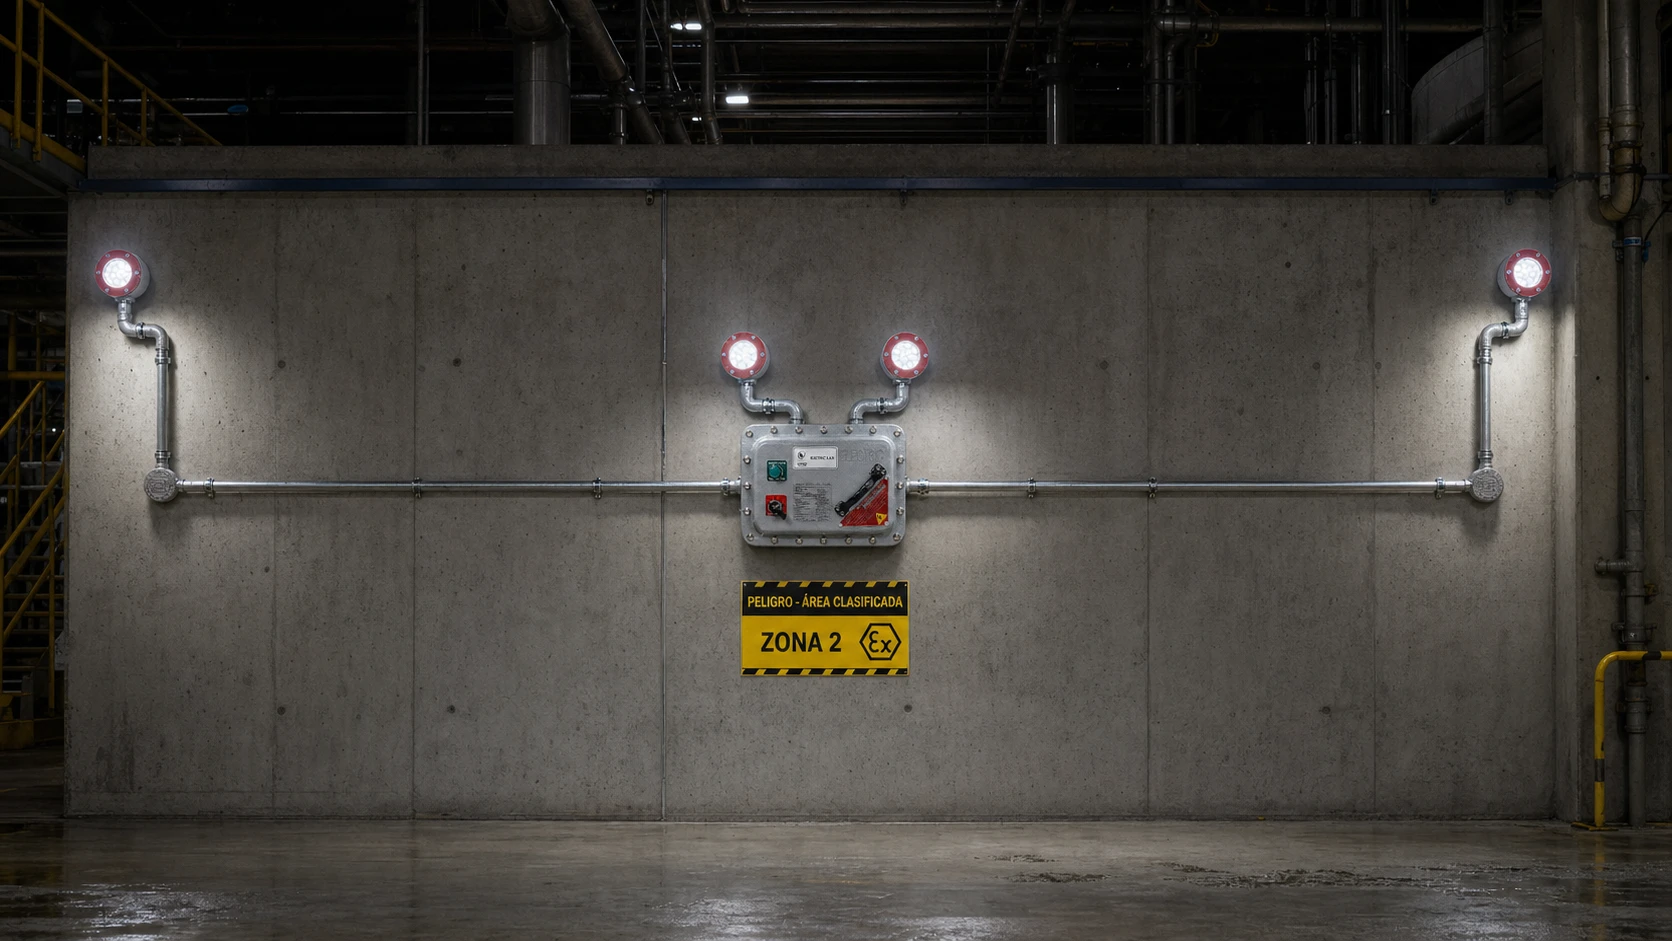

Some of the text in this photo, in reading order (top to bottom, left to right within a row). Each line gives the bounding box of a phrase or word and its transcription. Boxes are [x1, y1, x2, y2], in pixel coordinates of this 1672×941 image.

[748, 596, 793, 608] PELIGRO
[802, 593, 831, 608] ÁREA
[833, 596, 903, 608] CLASIFICADA
[761, 632, 842, 652] ZONA 2
